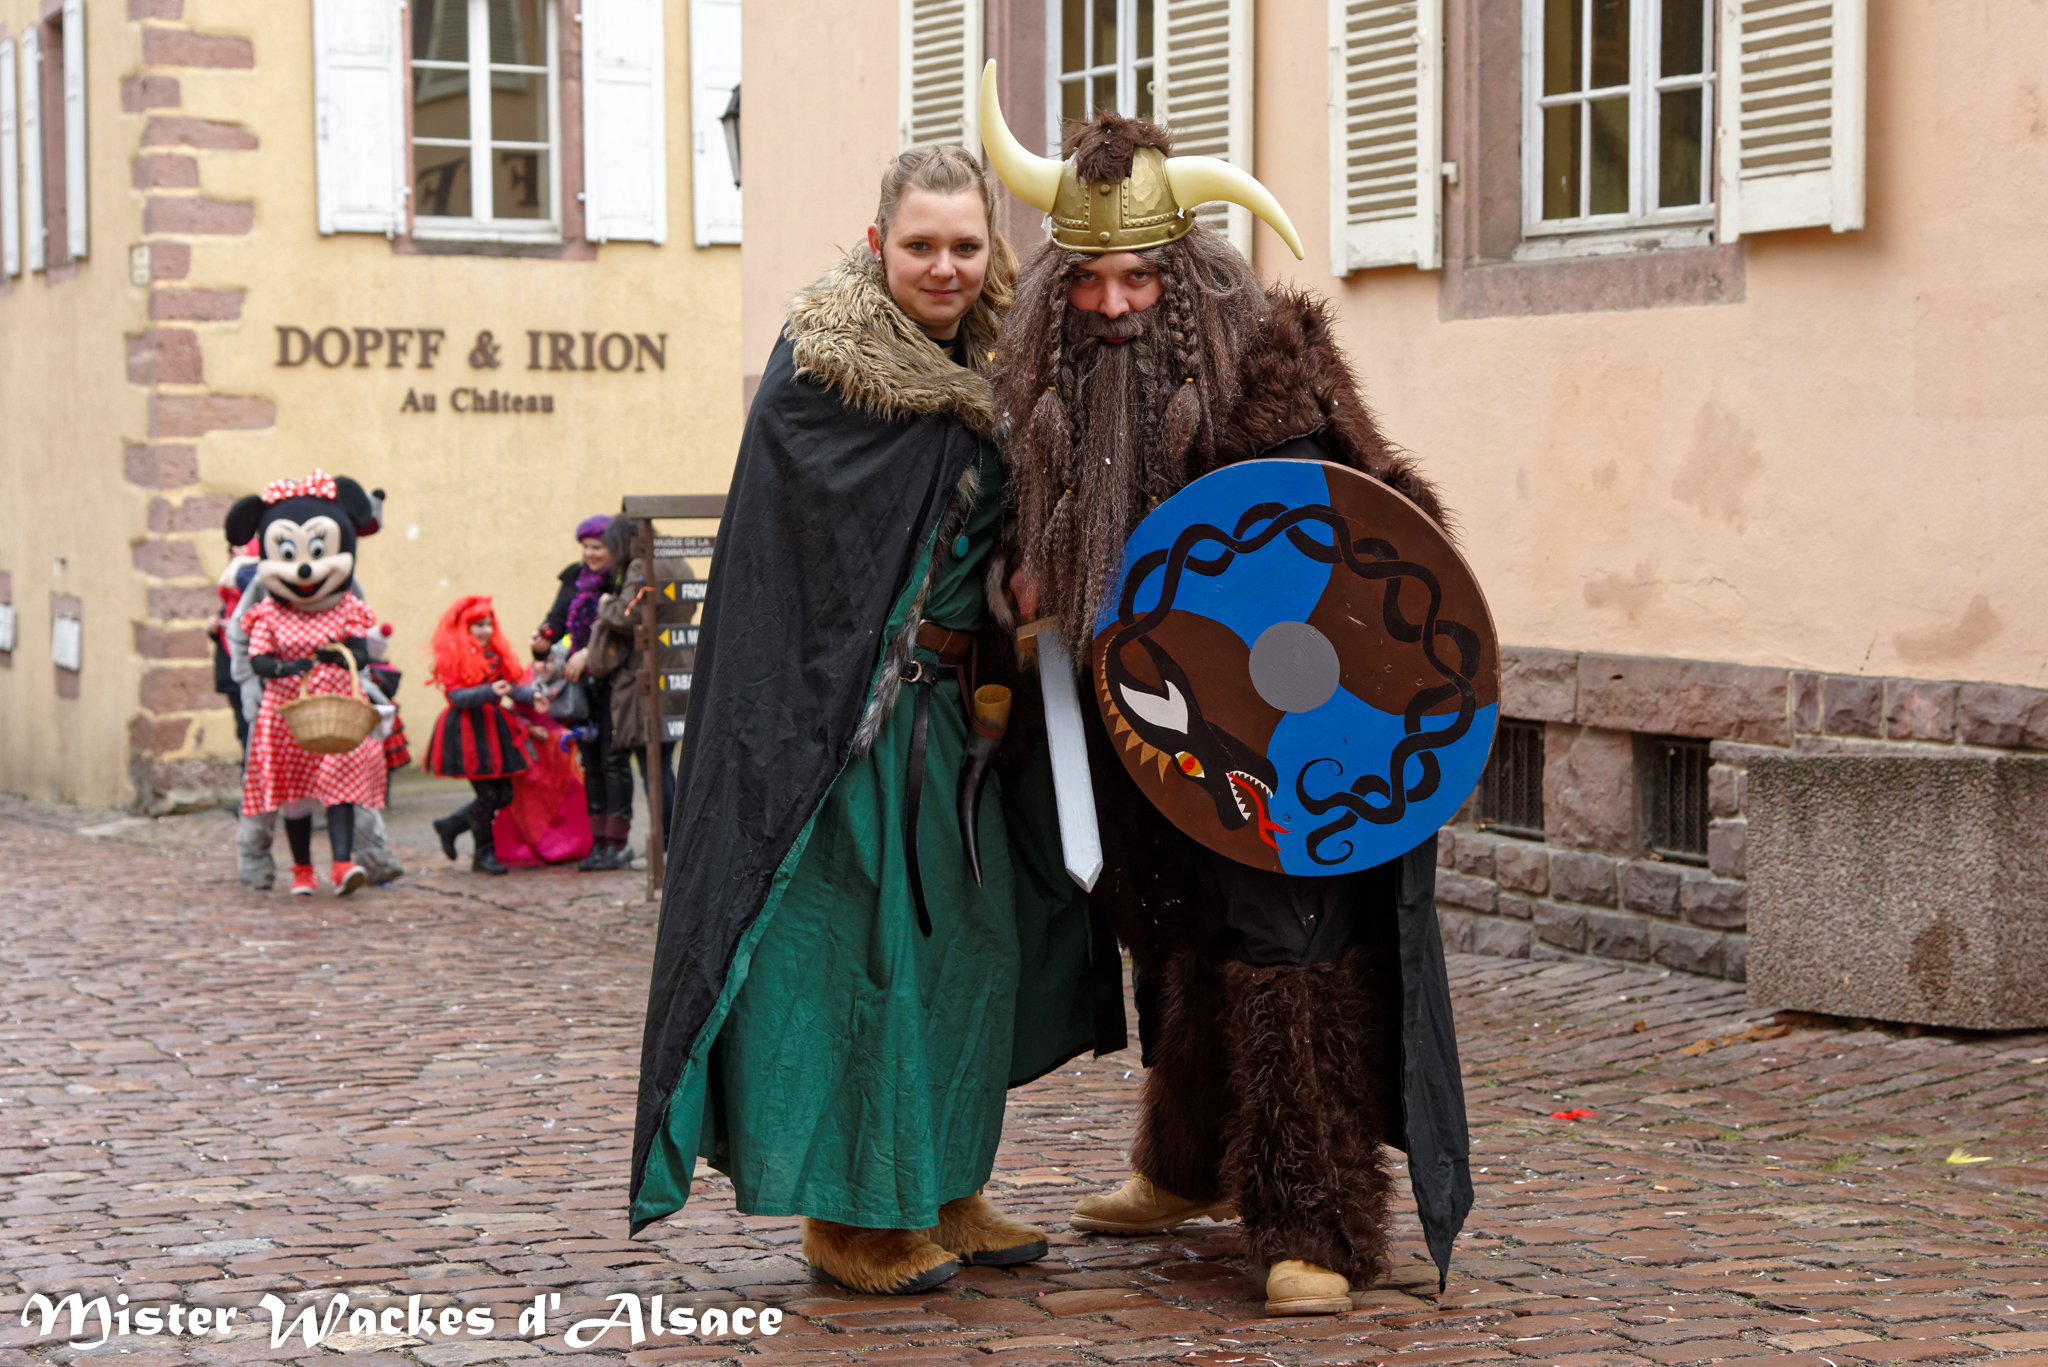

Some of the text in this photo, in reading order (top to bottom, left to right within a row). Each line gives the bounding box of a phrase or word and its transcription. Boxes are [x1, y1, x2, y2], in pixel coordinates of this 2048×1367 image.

[275, 325, 667, 372] DOPFF & IRION
[400, 387, 554, 413] Au Château
[698, 538, 711, 547] LA
[671, 629, 686, 646] LA
